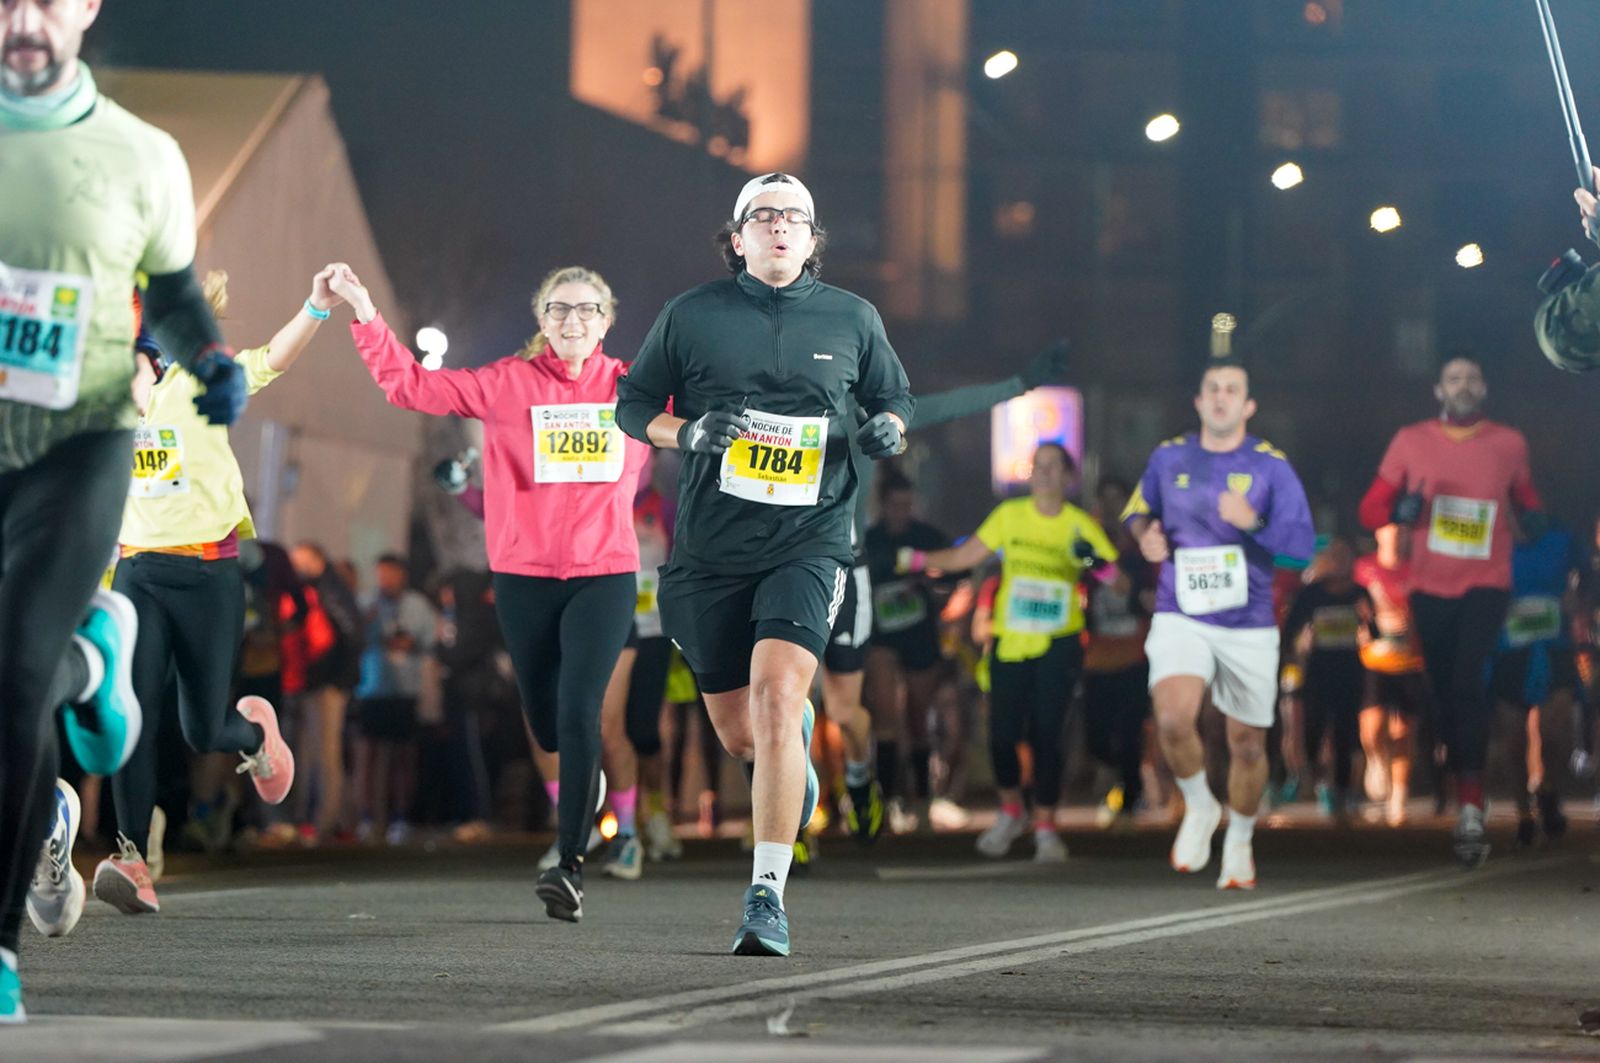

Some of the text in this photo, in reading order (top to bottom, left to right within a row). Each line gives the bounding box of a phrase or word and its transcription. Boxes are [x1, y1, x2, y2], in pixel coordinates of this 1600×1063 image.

[0, 315, 63, 358] 184
[739, 430, 757, 440] SAN
[760, 434, 792, 446] ANTÓN
[751, 421, 780, 433] NOCHE
[782, 426, 793, 434] DE
[546, 431, 613, 454] 12892
[133, 450, 167, 470] 148
[748, 444, 803, 474] 1784
